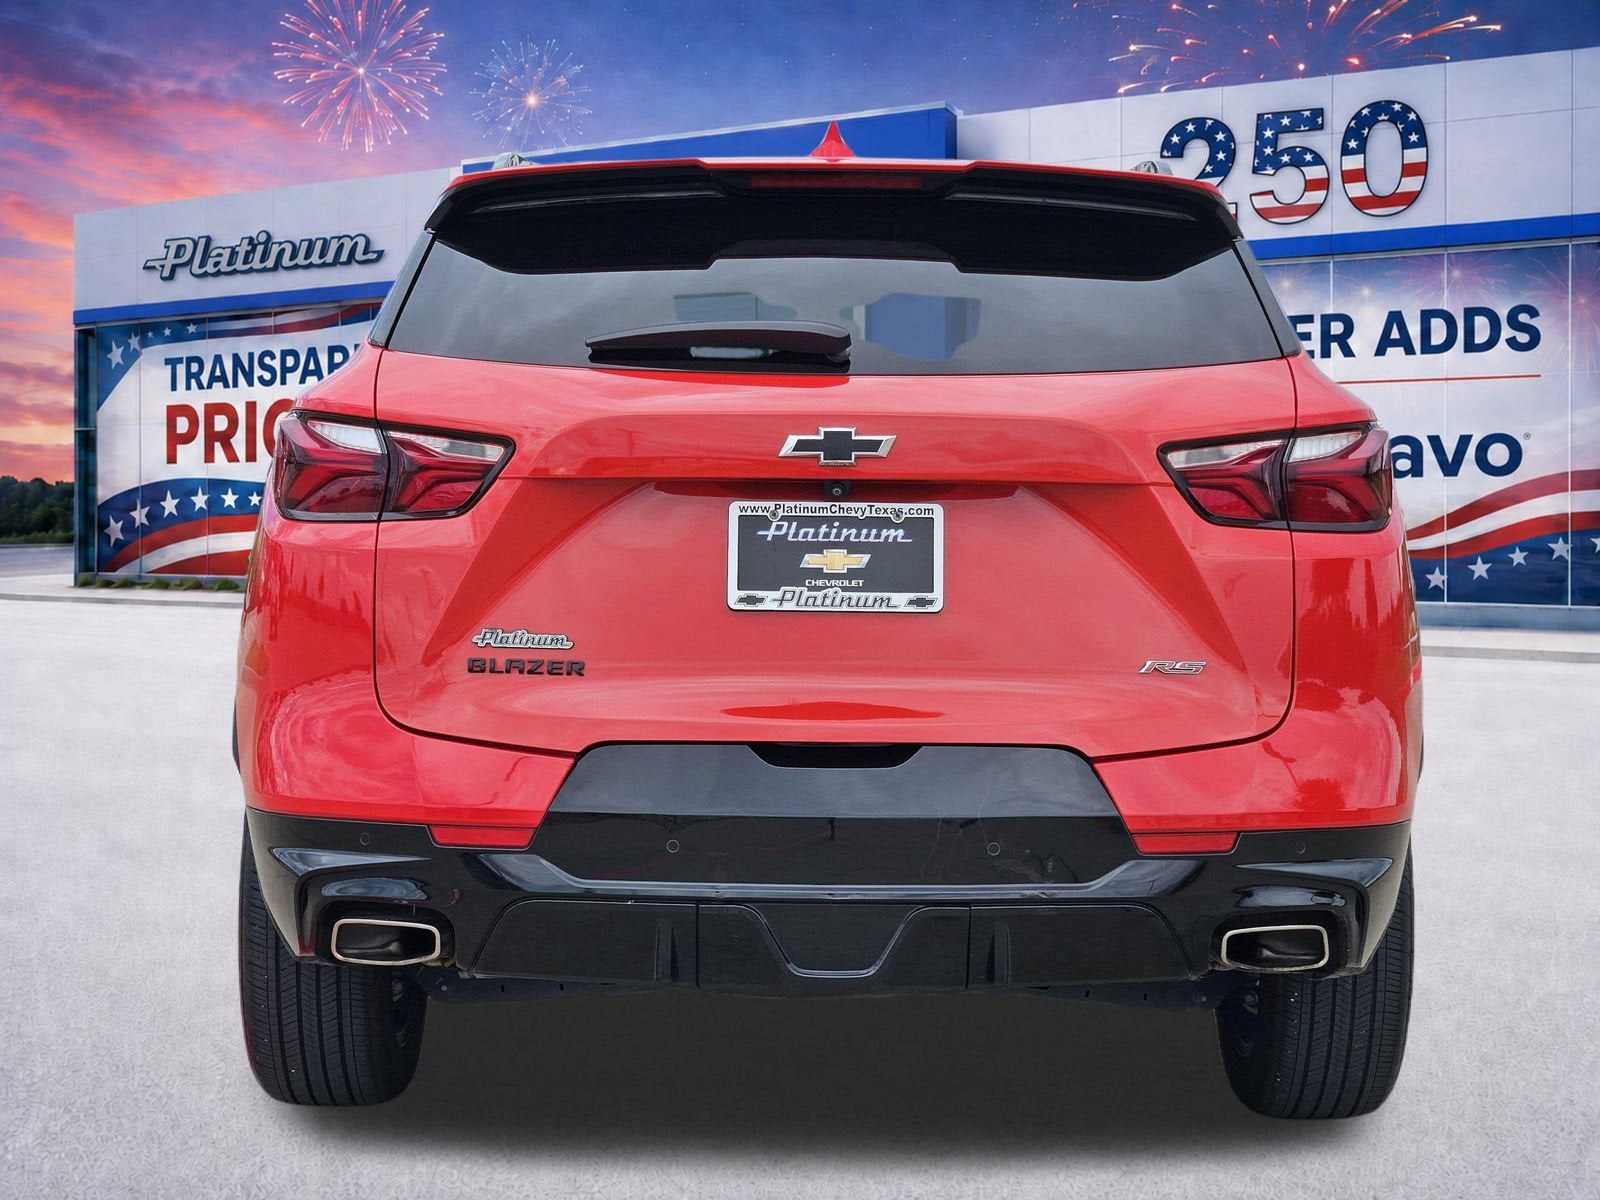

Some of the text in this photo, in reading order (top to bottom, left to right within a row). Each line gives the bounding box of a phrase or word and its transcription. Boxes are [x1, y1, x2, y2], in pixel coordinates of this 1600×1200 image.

[1160, 99, 1429, 225] 250
[142, 229, 385, 281] Platinum
[1374, 304, 1542, 357] ADDS
[164, 343, 361, 392] TRANSPAR
[738, 503, 934, 517] wwwPlatinumChevyTexas.com
[756, 521, 913, 543] Platinum
[805, 579, 865, 587] CHEVROLET
[770, 590, 902, 609] Platinum
[472, 628, 575, 650] Platinum
[467, 657, 586, 676] BLAZER
[1138, 660, 1207, 675] RS
